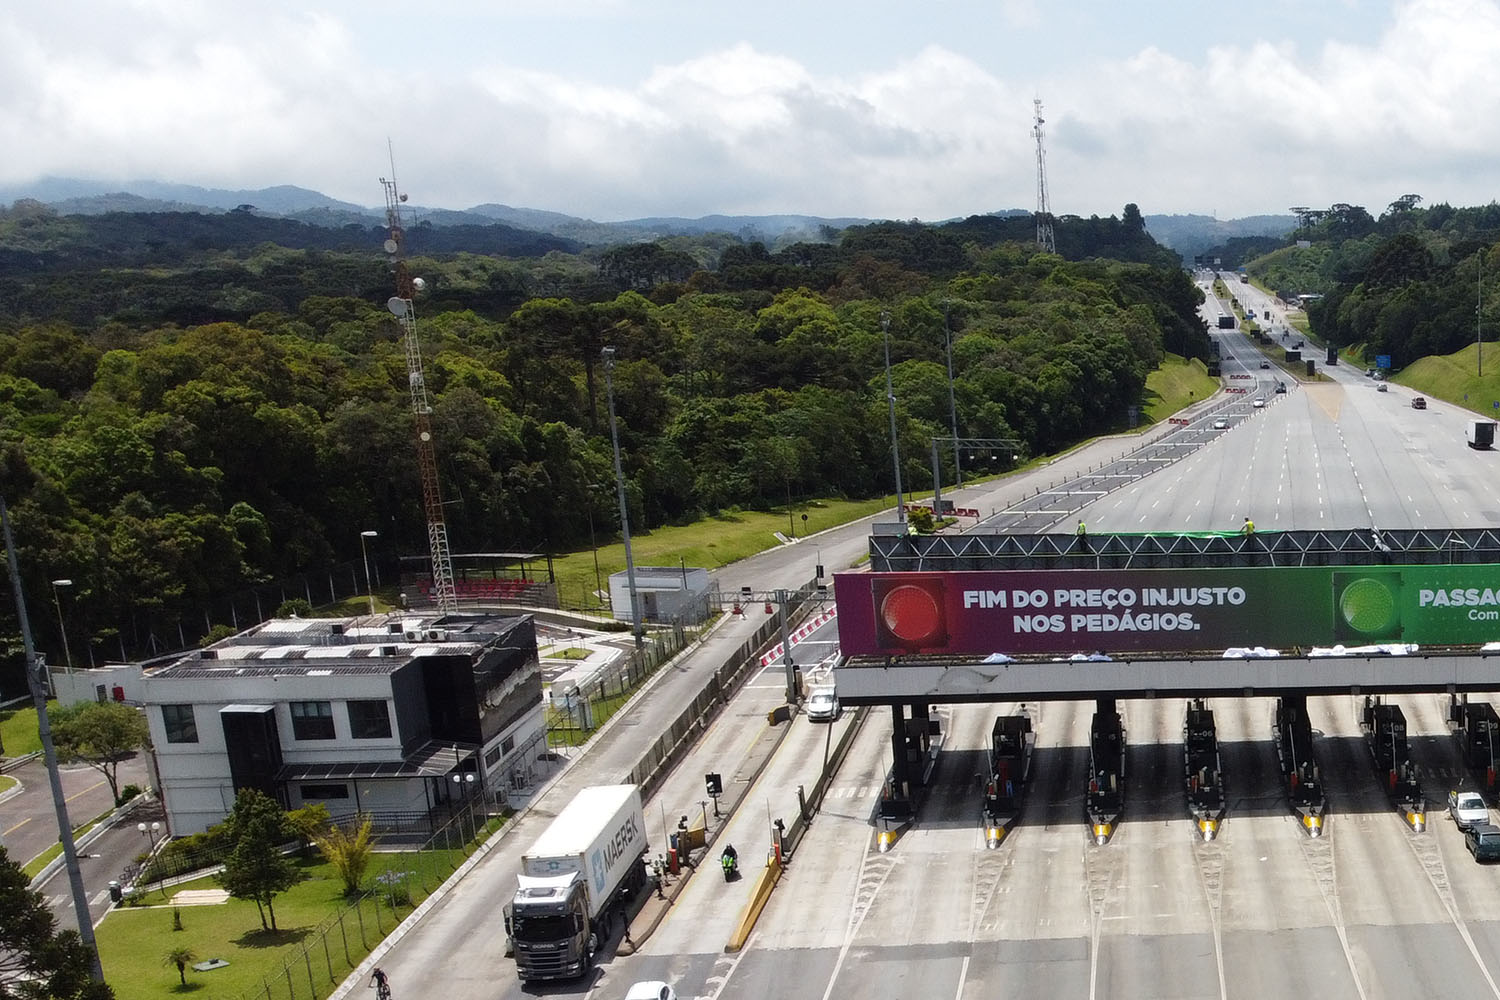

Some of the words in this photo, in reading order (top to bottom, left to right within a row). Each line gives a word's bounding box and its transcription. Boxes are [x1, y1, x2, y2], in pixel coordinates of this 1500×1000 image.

[963, 590, 1007, 608] FIM
[1012, 589, 1049, 608] DO
[1054, 588, 1137, 610] PREÇO
[1142, 587, 1246, 606] INJUSTO
[1013, 614, 1066, 633] NOS
[1071, 609, 1201, 632] PEDÁGIOS.
[1468, 609, 1498, 621] Com
[603, 811, 638, 873] MAERSK
